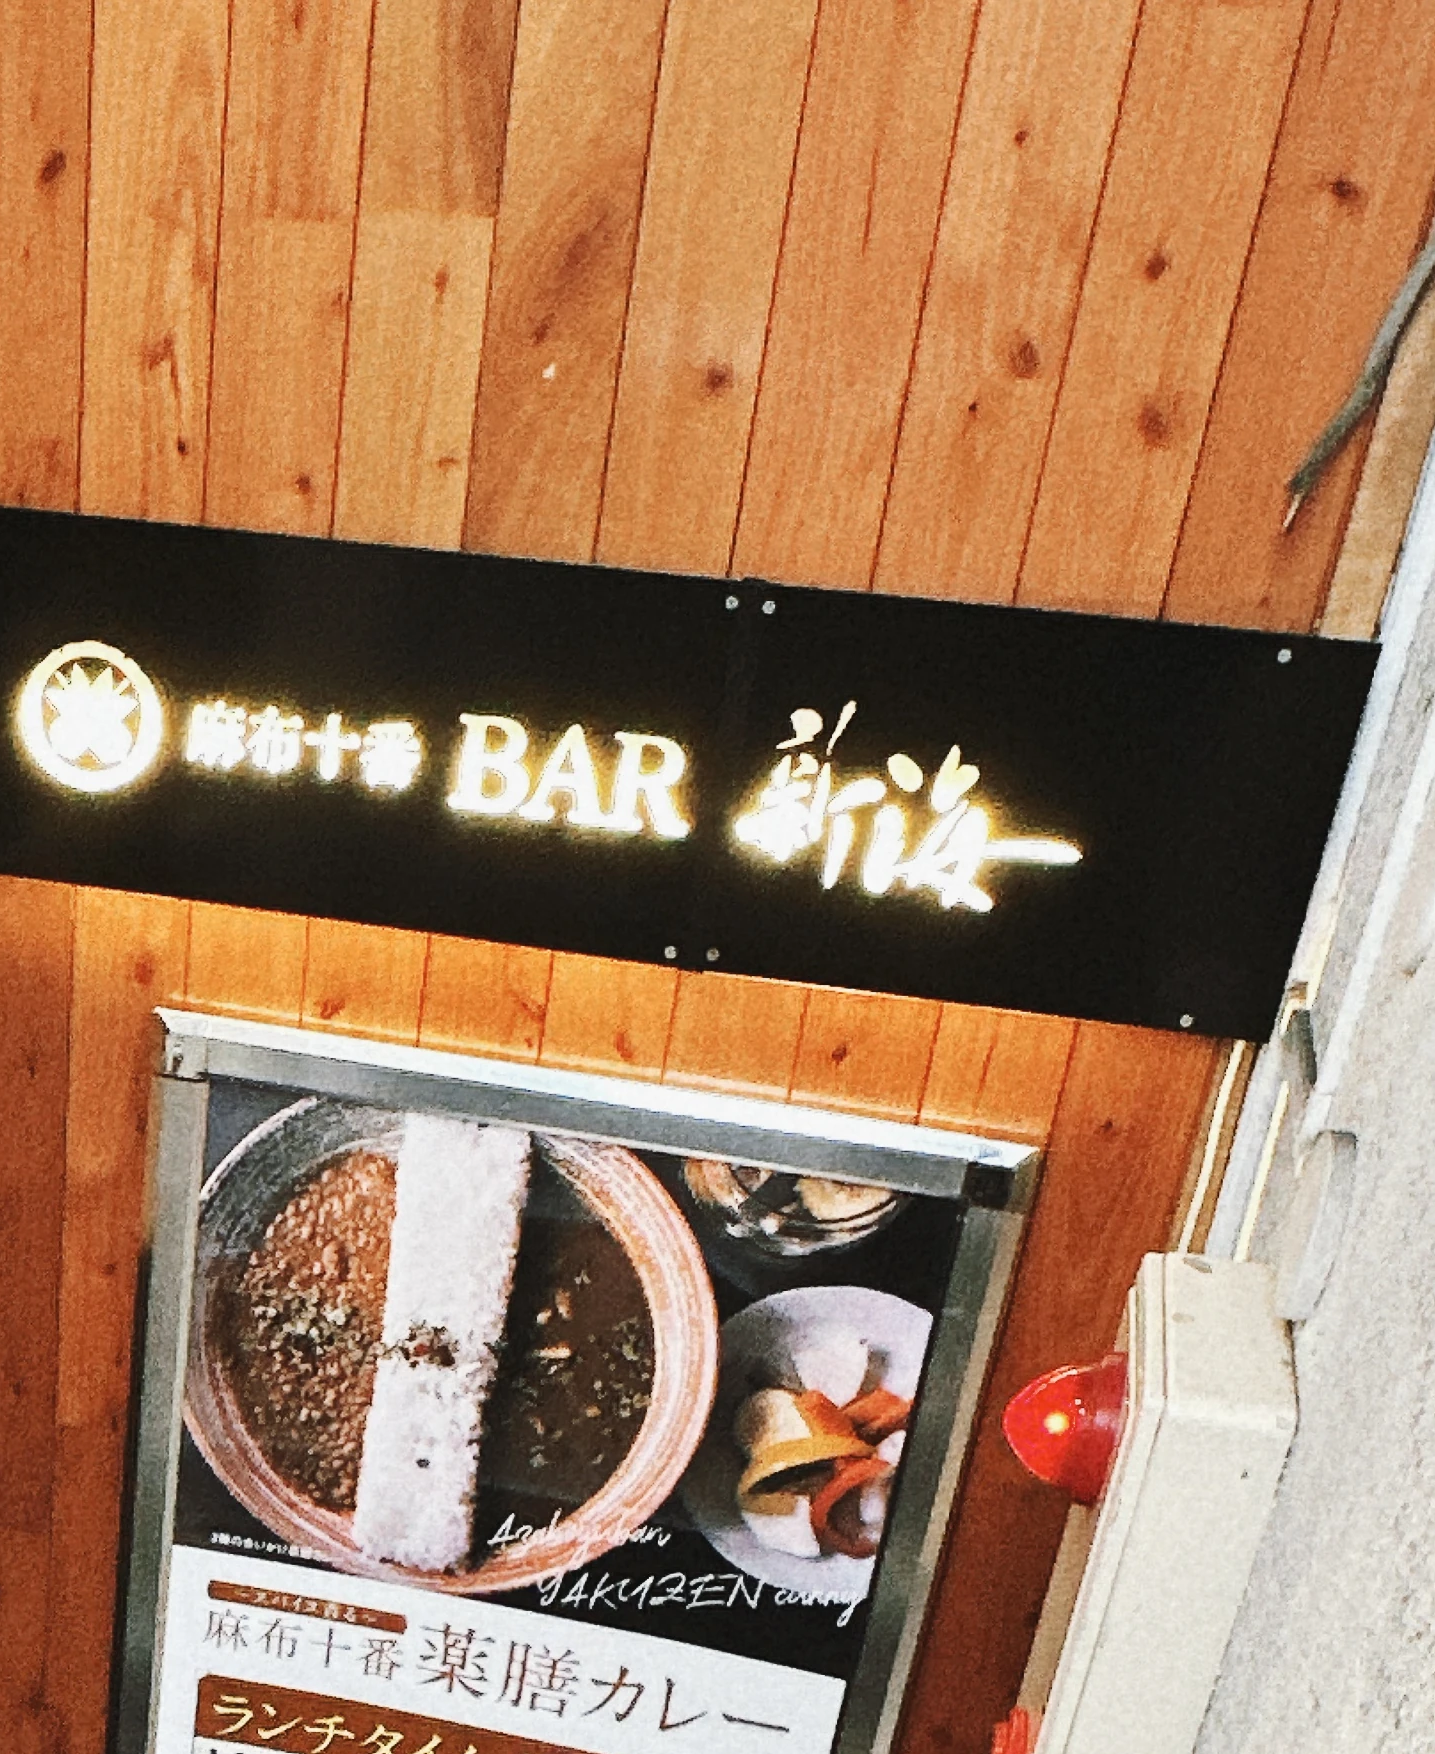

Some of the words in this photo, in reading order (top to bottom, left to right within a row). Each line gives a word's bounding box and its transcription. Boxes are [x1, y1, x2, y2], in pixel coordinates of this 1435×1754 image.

[186, 699, 421, 792] 麻布十番
[446, 710, 692, 840] BAR
